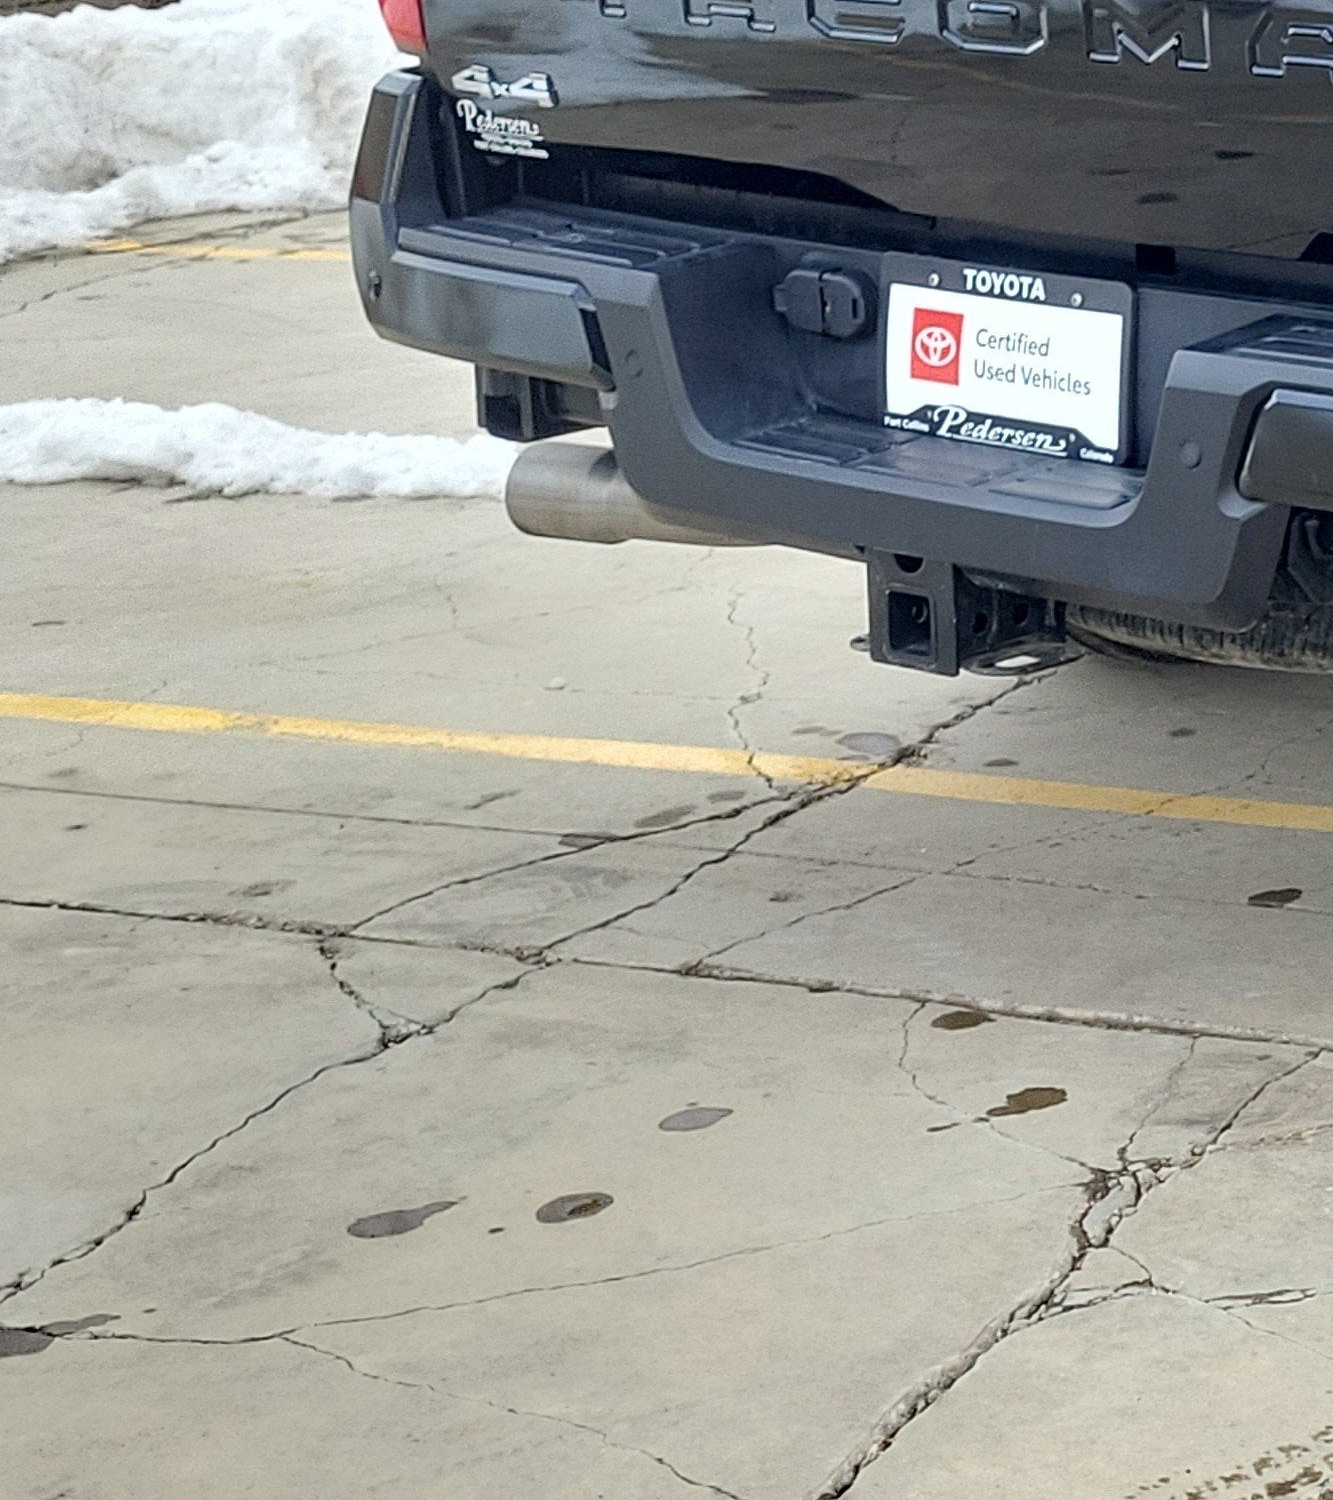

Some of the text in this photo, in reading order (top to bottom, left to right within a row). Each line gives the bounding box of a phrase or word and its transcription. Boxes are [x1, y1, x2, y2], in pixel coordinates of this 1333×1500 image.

[456, 98, 540, 136] Pedersen
[962, 268, 1047, 301] TOYOTA
[975, 328, 1051, 358] Certified
[973, 358, 1092, 396] Used Vehicles
[933, 405, 1067, 453] Pedersen
